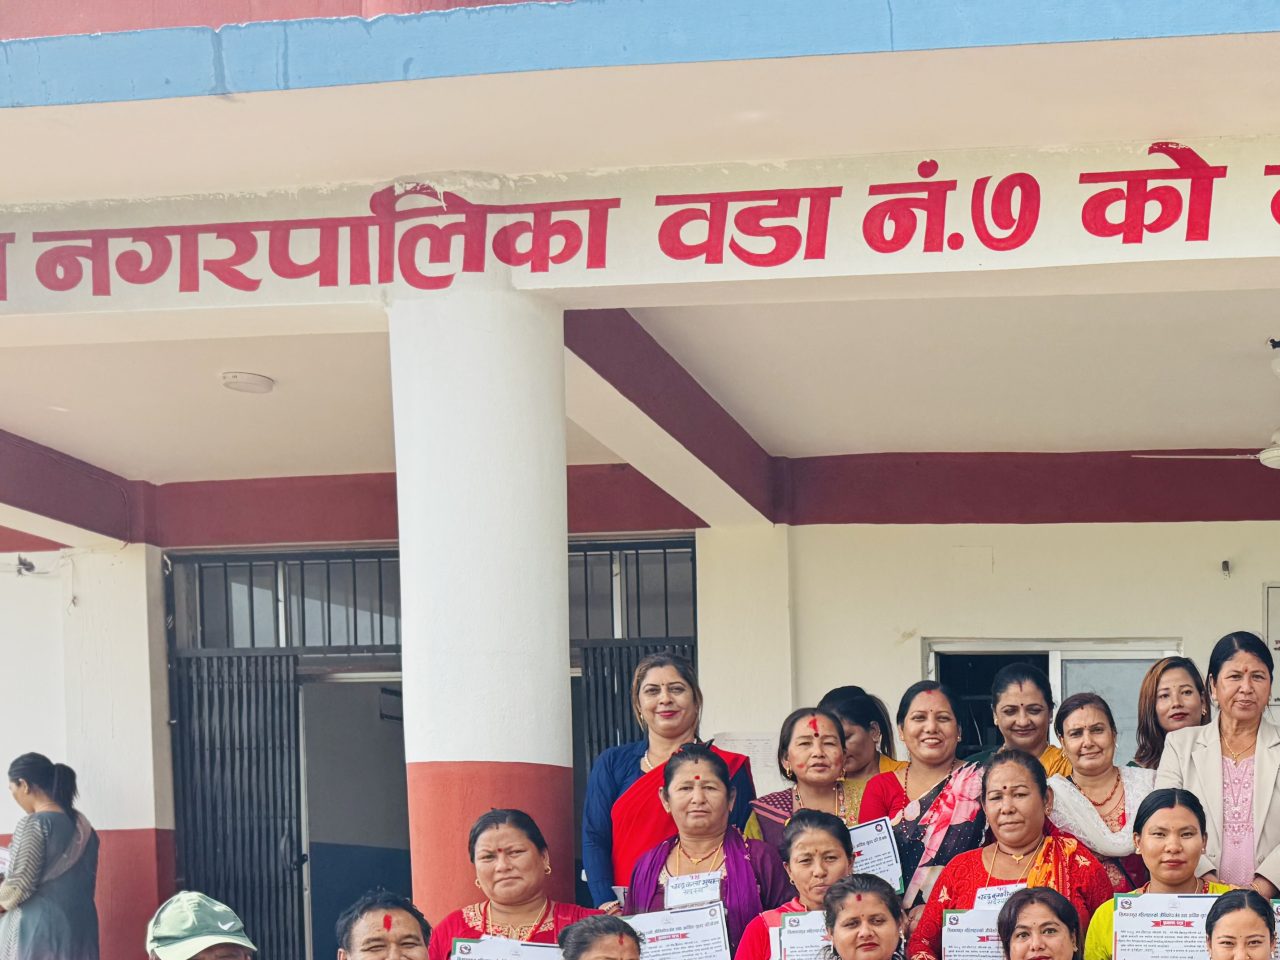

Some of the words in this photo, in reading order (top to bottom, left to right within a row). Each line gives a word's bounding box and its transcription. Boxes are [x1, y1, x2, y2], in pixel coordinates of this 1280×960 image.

[34, 183, 621, 291] नगरपालिका
[655, 186, 843, 267] वडा
[1079, 141, 1228, 245] को
